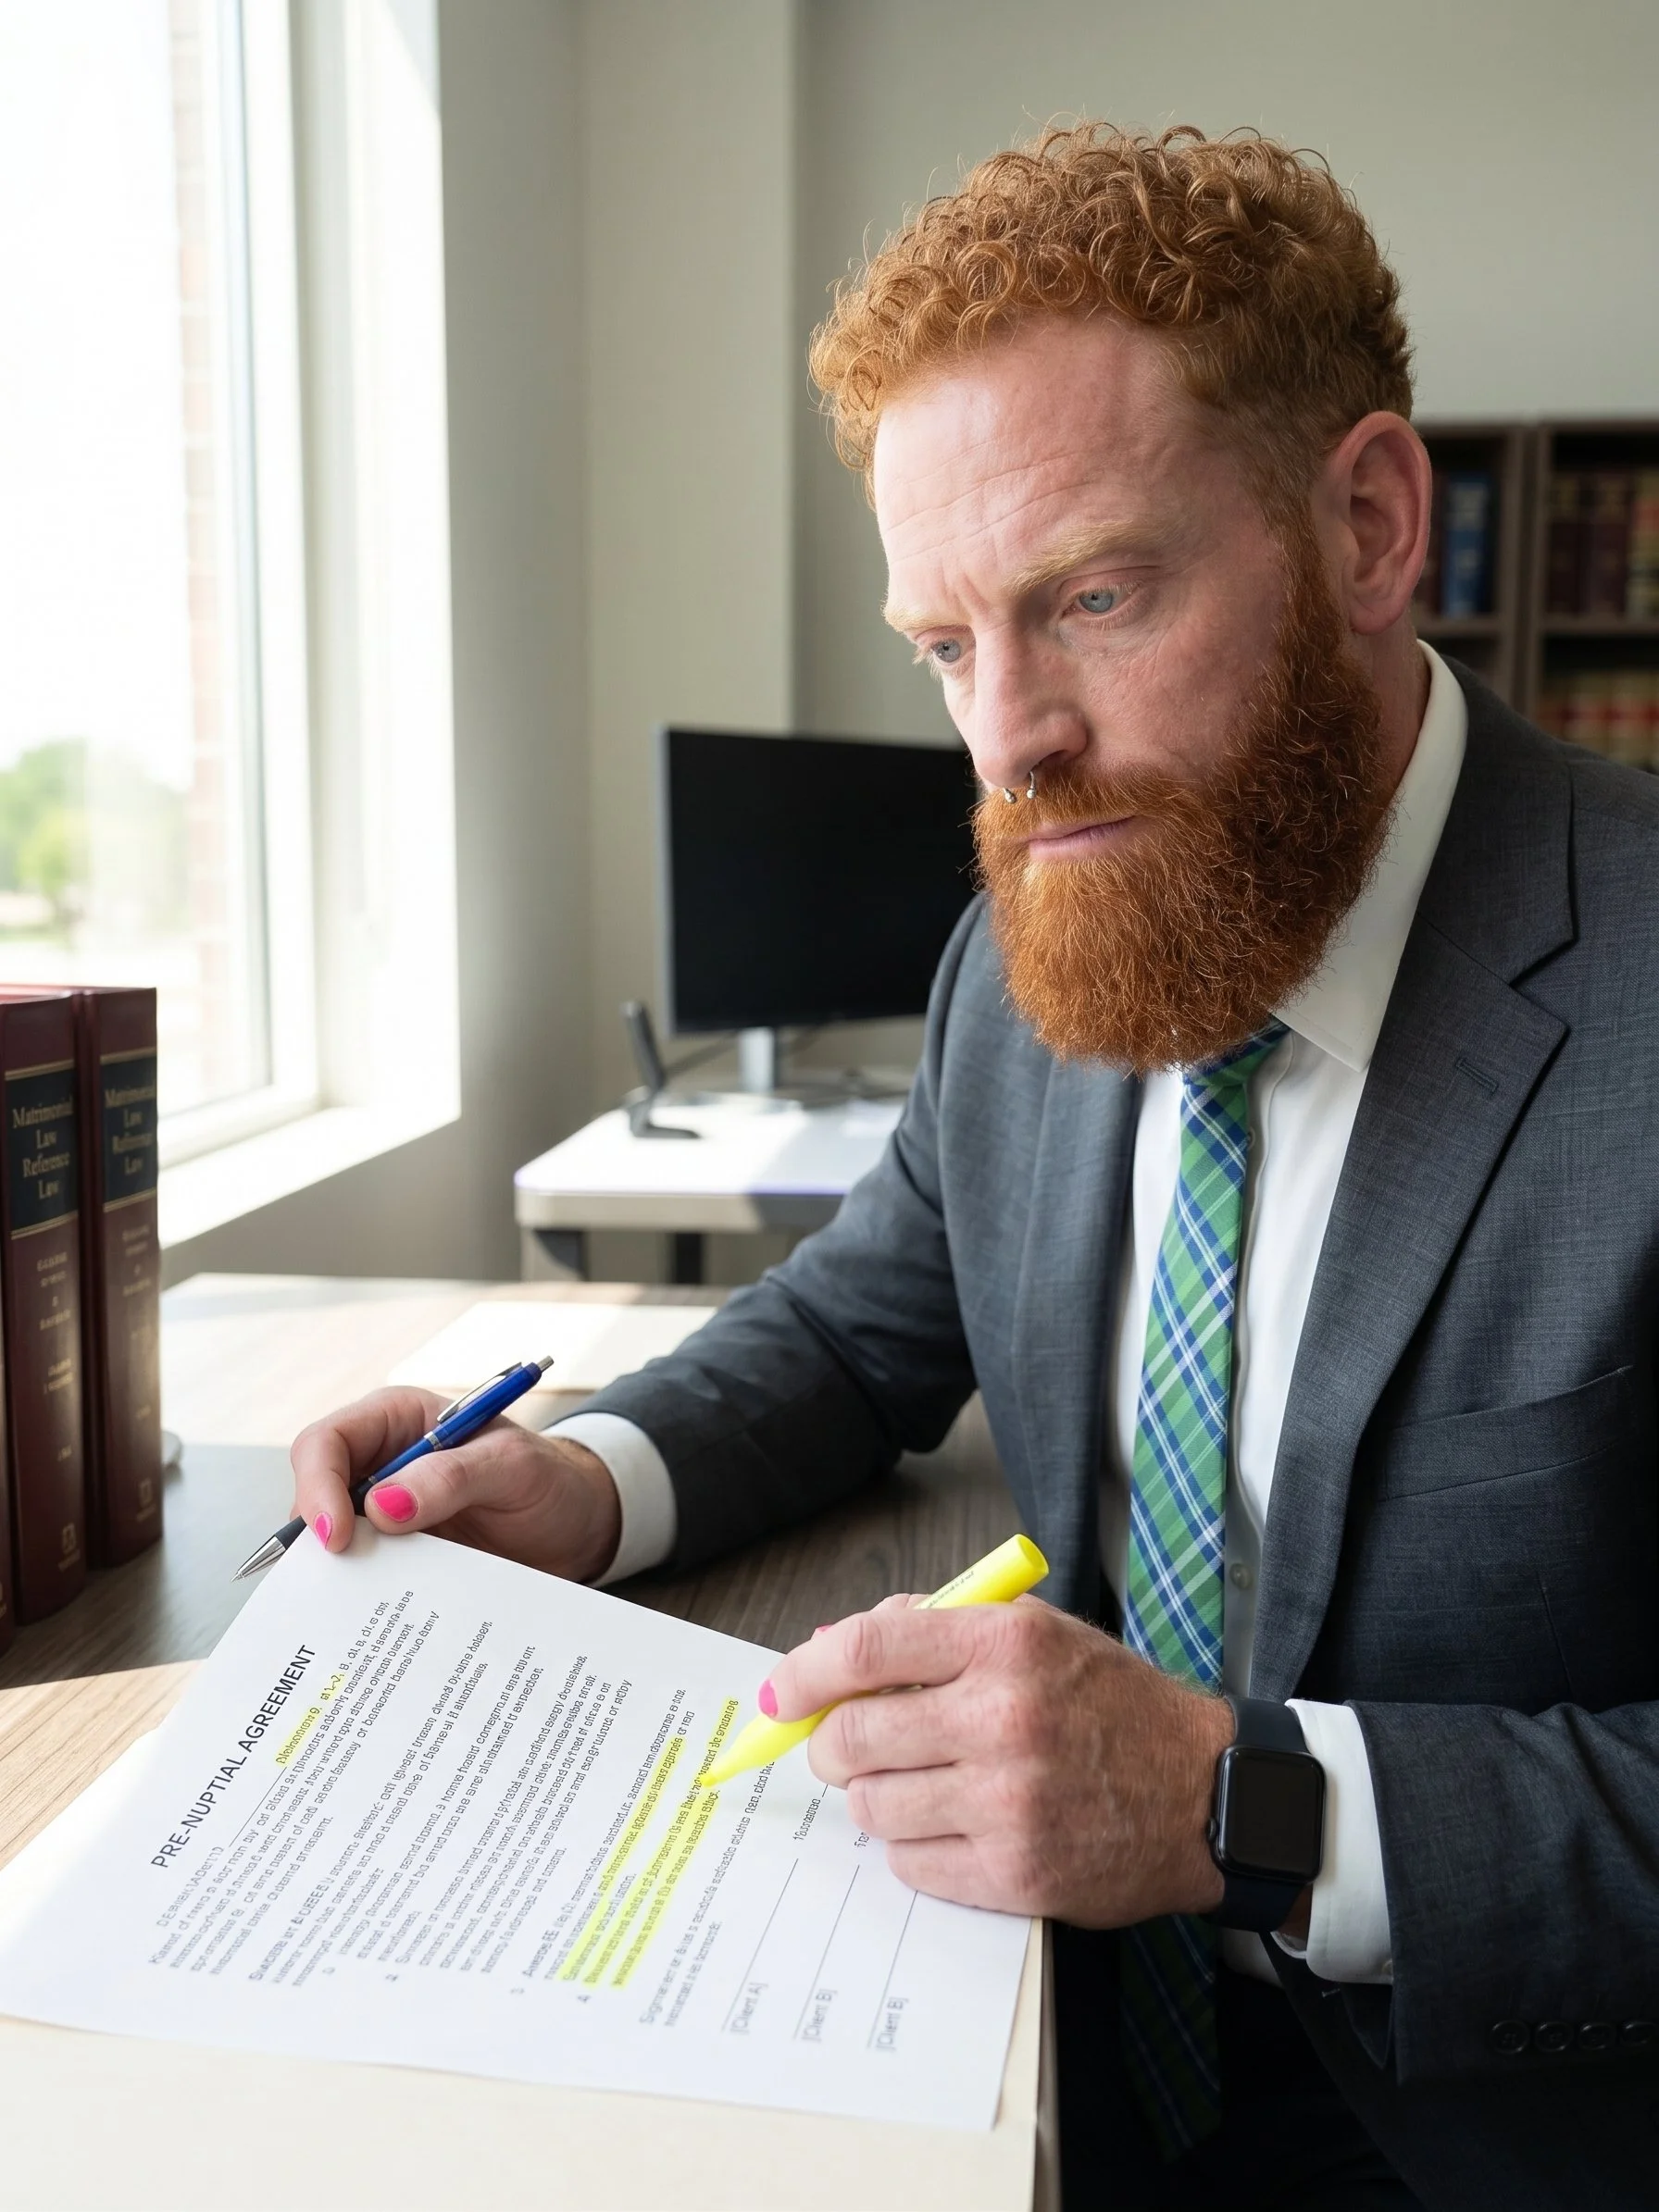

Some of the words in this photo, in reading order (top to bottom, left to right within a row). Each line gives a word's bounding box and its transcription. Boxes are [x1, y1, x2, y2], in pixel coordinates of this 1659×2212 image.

[36, 1129, 57, 1149] Law
[39, 1180, 59, 1199] Law
[151, 1756, 247, 1868] PRE-NUPTIAL
[238, 1645, 316, 1752] AGREEMENT
